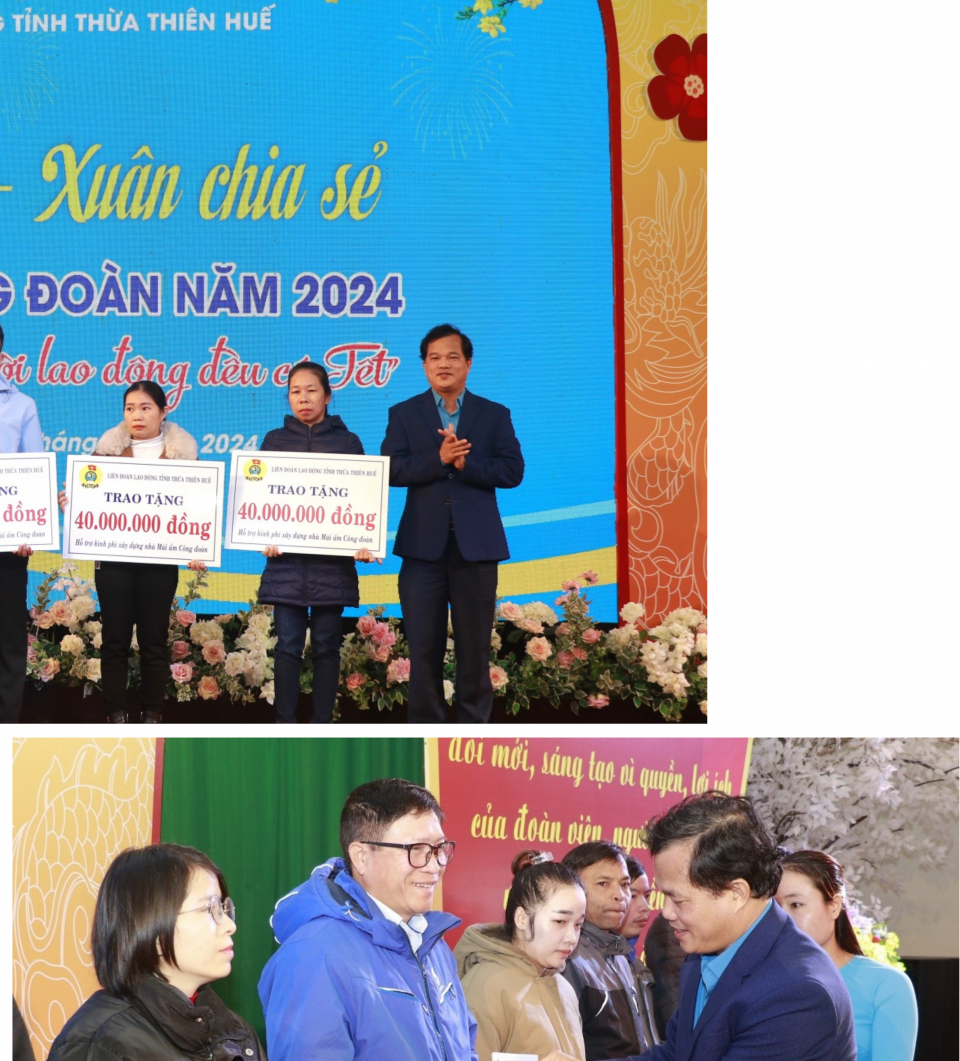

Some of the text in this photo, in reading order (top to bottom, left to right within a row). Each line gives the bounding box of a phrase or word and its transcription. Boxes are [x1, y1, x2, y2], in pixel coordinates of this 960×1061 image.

[12, 8, 69, 33] TỈNH
[74, 8, 140, 33] THỪA
[147, 8, 218, 31] THIÊN
[225, 4, 274, 31] HUẾ
[33, 142, 183, 223] Xuân
[199, 143, 307, 222] chia
[319, 141, 389, 221] sẻ
[25, 259, 162, 316] ĐOÀN
[173, 262, 281, 316] NĂM
[292, 272, 405, 316] 2024
[36, 334, 96, 386] lao
[101, 334, 191, 412] động
[197, 336, 269, 387] đều
[41, 431, 258, 456] háng 2024
[104, 492, 183, 507] TRAO TẶNG
[268, 485, 348, 498] TRAO TẶNG
[3, 501, 46, 525] đồng
[75, 511, 211, 540] 40.000.000 đồng
[238, 502, 376, 531] 40.000.000 đồng
[491, 738, 536, 781] mới,
[541, 746, 584, 788] sáng
[588, 751, 616, 790] tạo
[620, 758, 635, 786] vì
[640, 759, 688, 799] quyền,
[471, 803, 507, 840] của
[513, 803, 563, 845] đoàn
